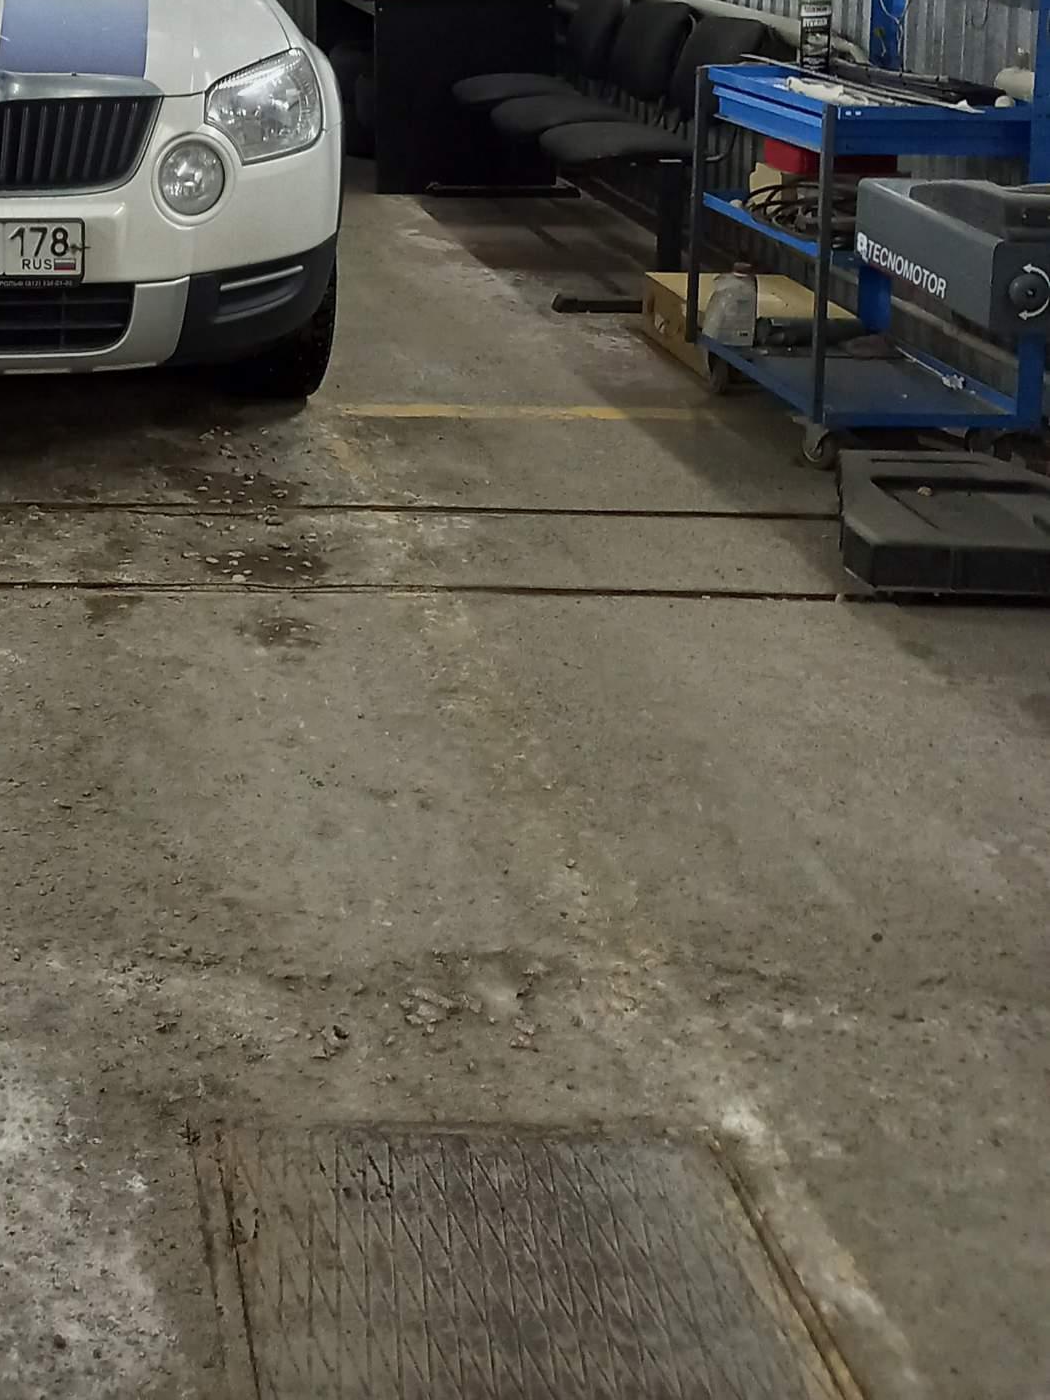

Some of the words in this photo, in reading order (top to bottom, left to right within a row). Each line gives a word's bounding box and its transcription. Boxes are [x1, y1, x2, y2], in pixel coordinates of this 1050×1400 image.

[8, 226, 69, 257] 178
[21, 258, 53, 270] RUS
[867, 239, 947, 299] TECNOMOTOR
